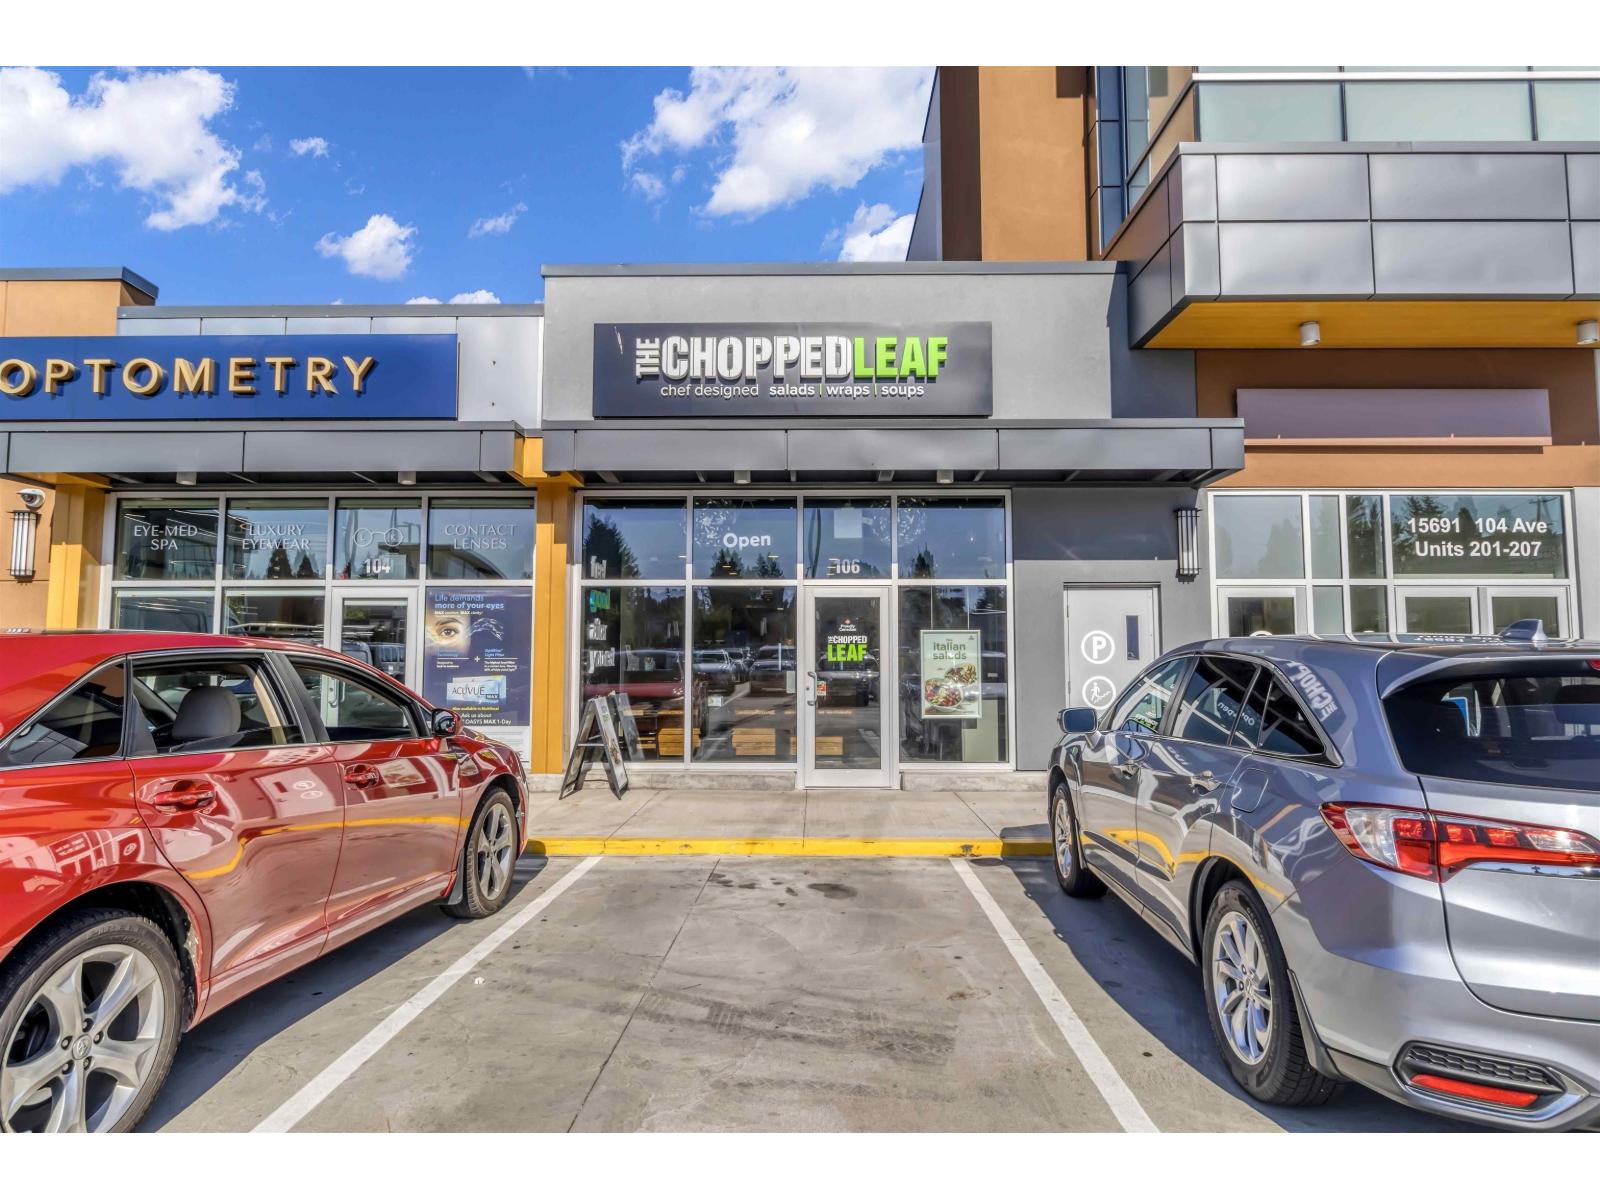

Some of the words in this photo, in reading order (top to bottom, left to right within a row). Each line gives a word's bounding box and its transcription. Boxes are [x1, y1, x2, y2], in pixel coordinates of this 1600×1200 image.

[635, 337, 661, 381] THE
[661, 335, 853, 382] CHOPPED
[853, 336, 949, 380] LEAF
[0, 356, 375, 396] OPTOMETRY
[660, 384, 691, 397] chef
[694, 384, 760, 399] designed
[769, 384, 816, 398] salads
[826, 386, 870, 400] wraps
[881, 386, 925, 400] soups
[133, 525, 198, 538] EYE-MED
[249, 524, 305, 537] LUXURY
[444, 524, 516, 537] CONTACT
[1407, 517, 1460, 534] 15691
[1475, 517, 1508, 534] 104
[1511, 518, 1548, 534] Ave
[150, 539, 179, 551] SPA
[242, 538, 311, 550] EYEWEAR
[453, 538, 507, 550] LENSES
[723, 533, 771, 551] Open
[1415, 541, 1465, 557] Units
[1469, 541, 1542, 557] 201-207
[365, 558, 391, 574] 104
[835, 558, 861, 574] 106
[456, 601, 465, 609] of
[466, 603, 485, 611] your
[486, 603, 505, 611] eyes
[833, 635, 868, 644] CHOPPED
[933, 641, 966, 651] italian
[827, 644, 868, 662] LEAF
[451, 686, 485, 696] ACUVUE
